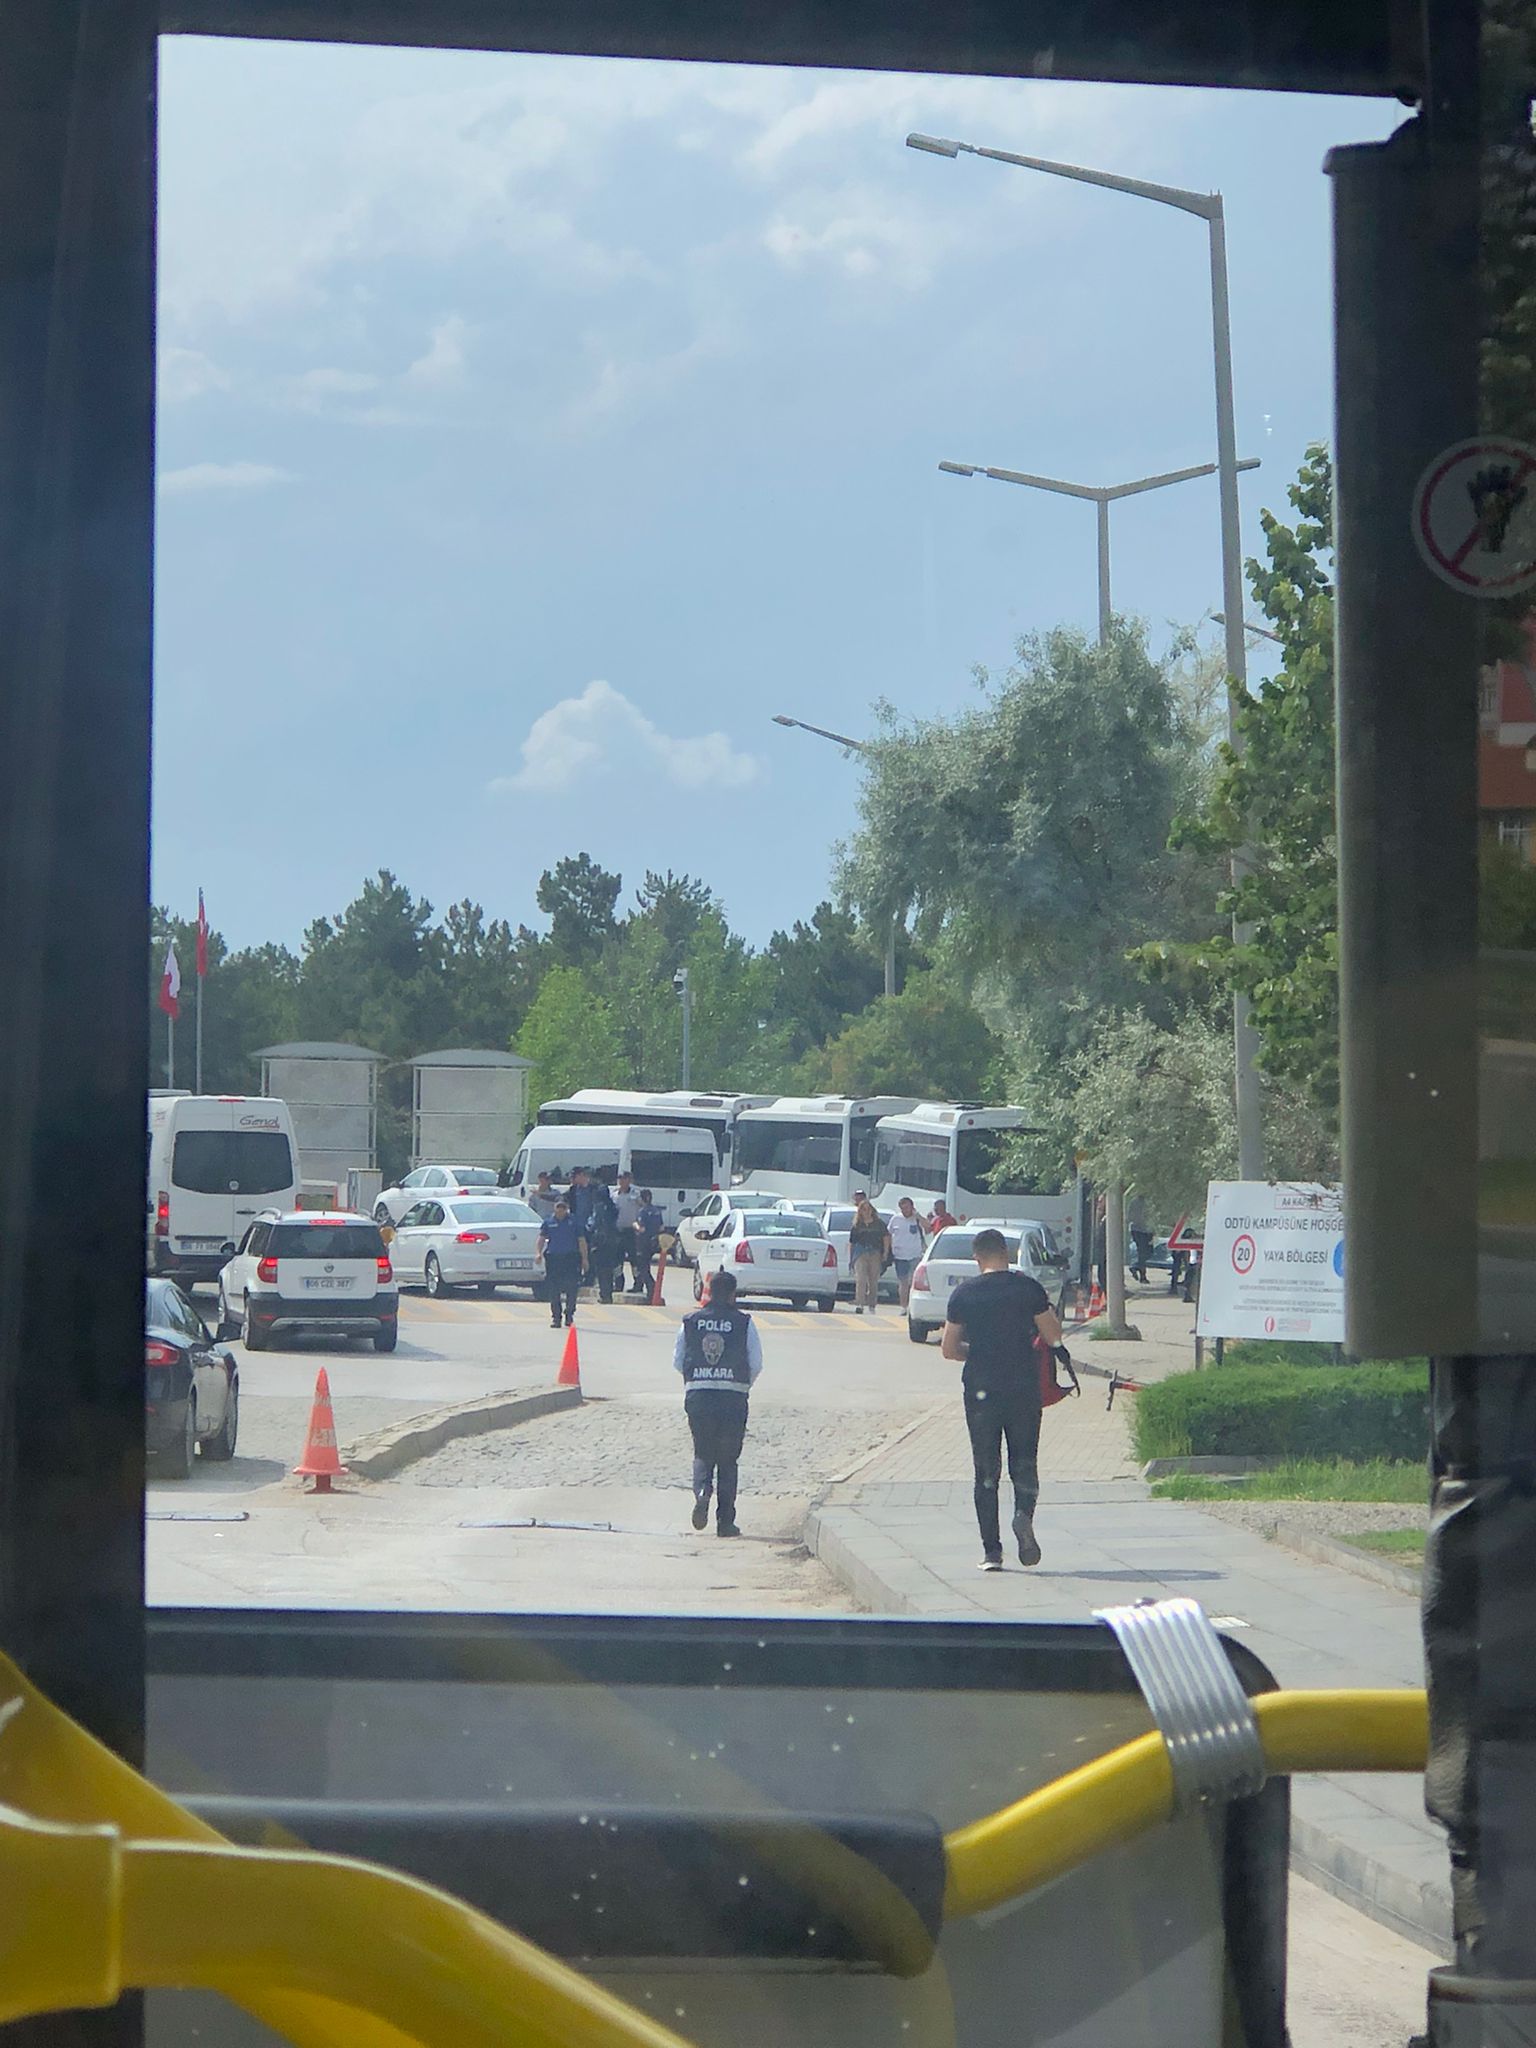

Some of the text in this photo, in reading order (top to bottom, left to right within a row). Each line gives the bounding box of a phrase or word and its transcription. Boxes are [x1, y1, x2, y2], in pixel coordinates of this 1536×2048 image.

[1224, 1216, 1345, 1233] ODTÜ KAMPÜSÜNE HOŞGE
[1237, 1247, 1250, 1261] 20
[1264, 1248, 1328, 1264] YAYA BÖLGESİ
[697, 1319, 733, 1332] POLİS
[693, 1367, 734, 1379] ANKARA
